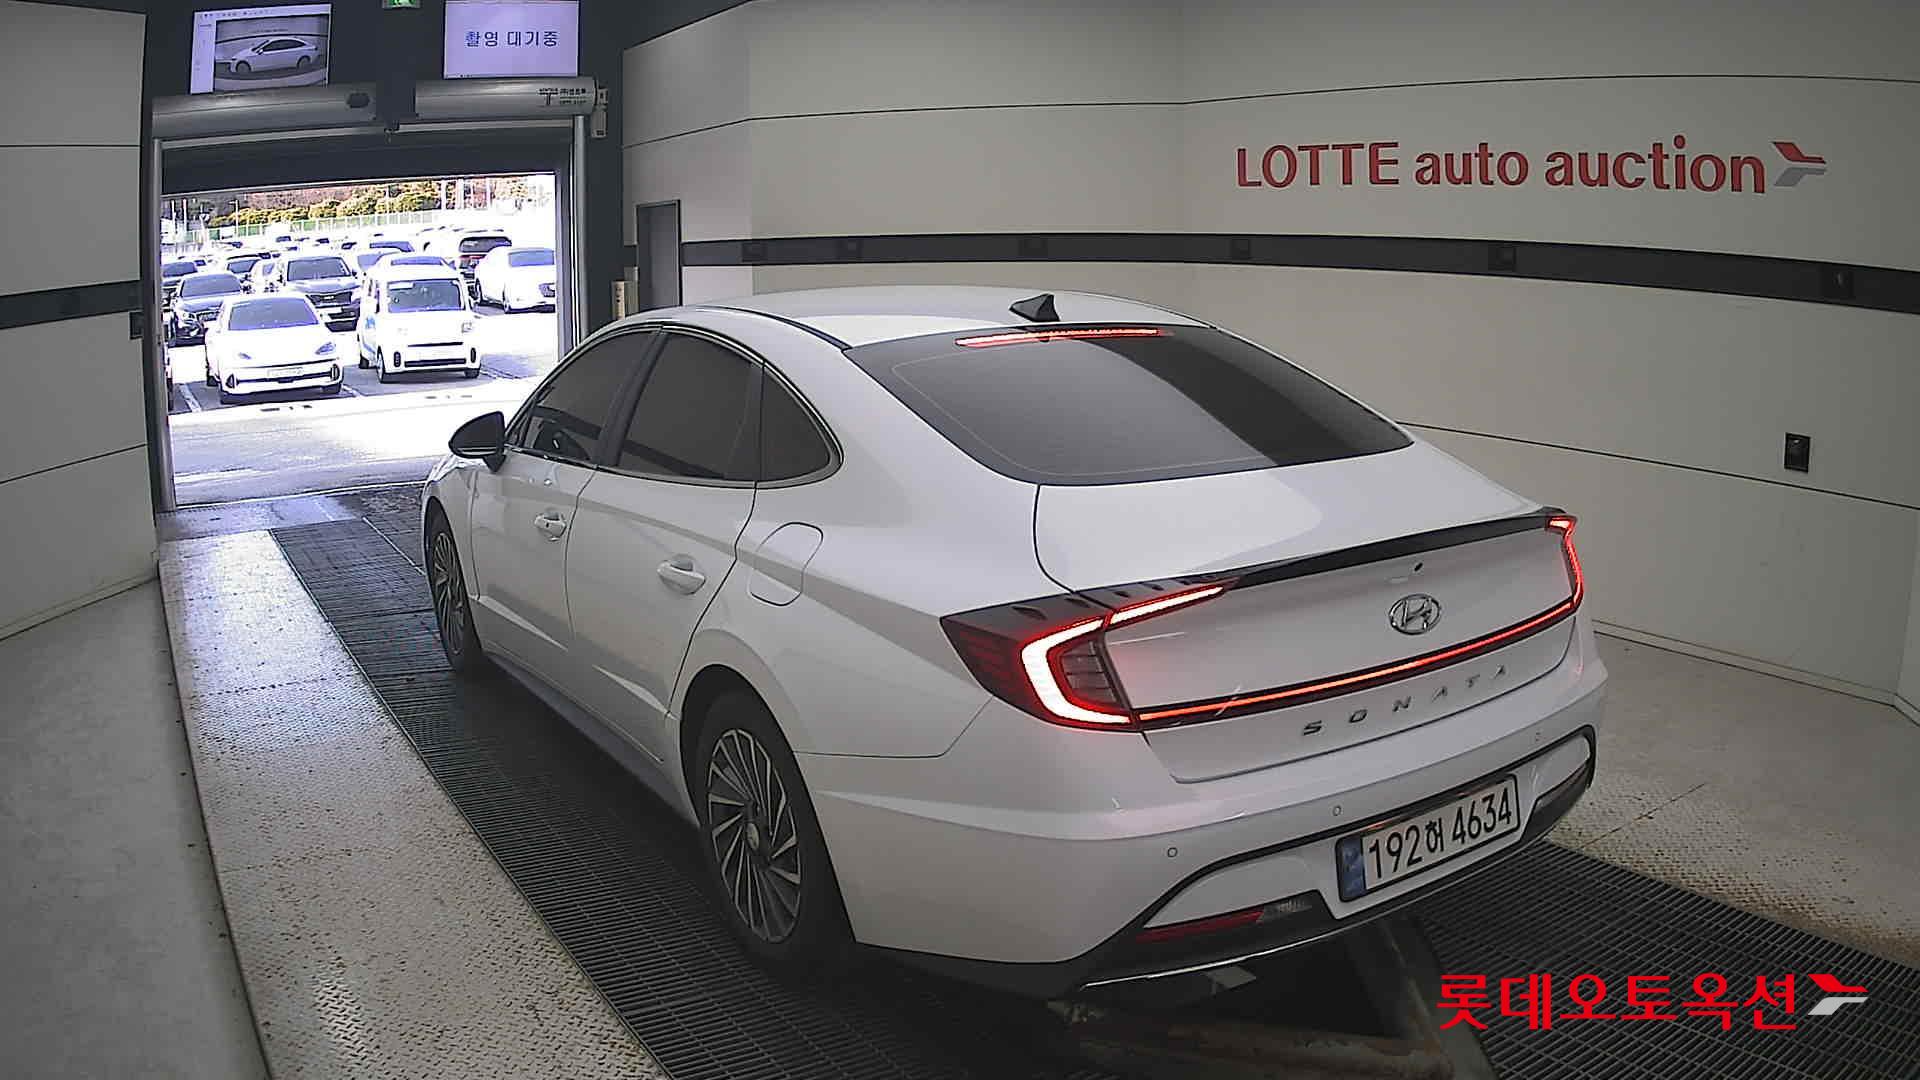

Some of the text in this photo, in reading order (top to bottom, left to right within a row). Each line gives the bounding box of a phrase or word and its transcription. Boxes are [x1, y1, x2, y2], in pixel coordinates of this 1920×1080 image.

[507, 31, 558, 47] 대기중
[1237, 134, 1766, 194] LOTTE auto auction
[1302, 664, 1506, 736] SONATA
[1368, 787, 1512, 879] 192허 4634
